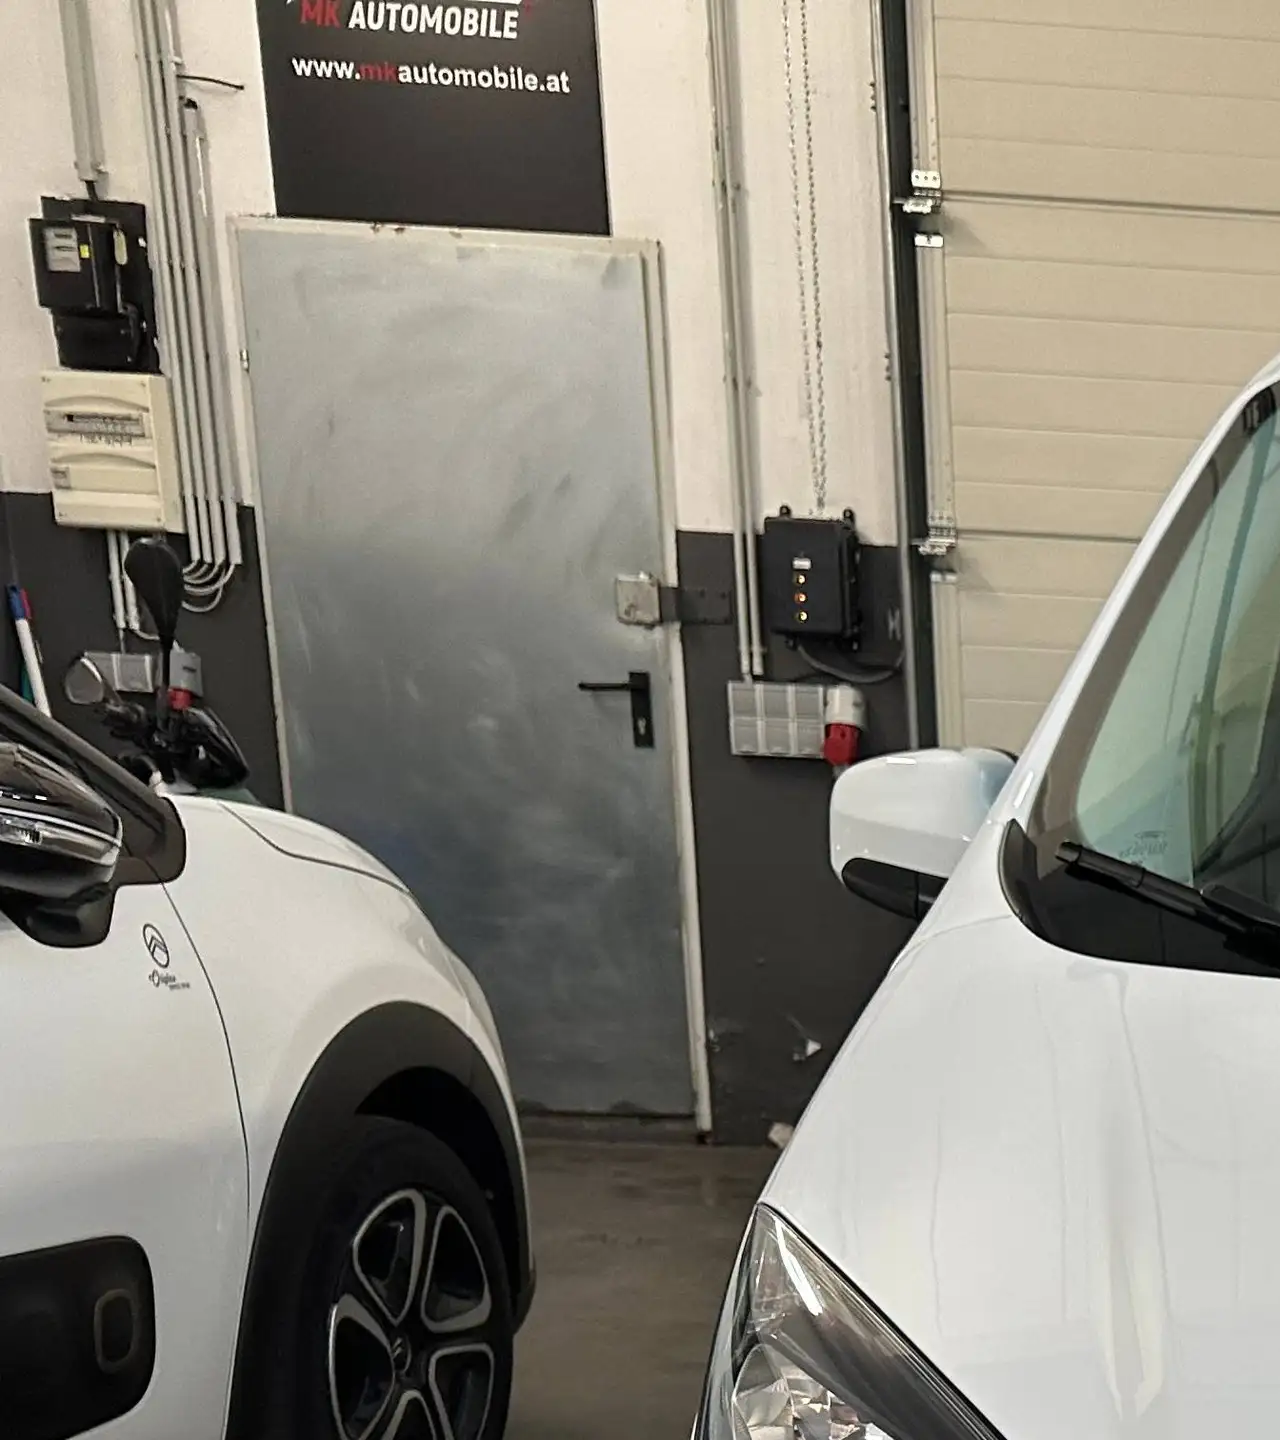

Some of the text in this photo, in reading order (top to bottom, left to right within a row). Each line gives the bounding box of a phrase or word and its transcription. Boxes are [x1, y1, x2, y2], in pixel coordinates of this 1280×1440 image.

[300, 0, 519, 39] MK AUTOMOBILE
[291, 57, 571, 94] www.mkautomobile.at
